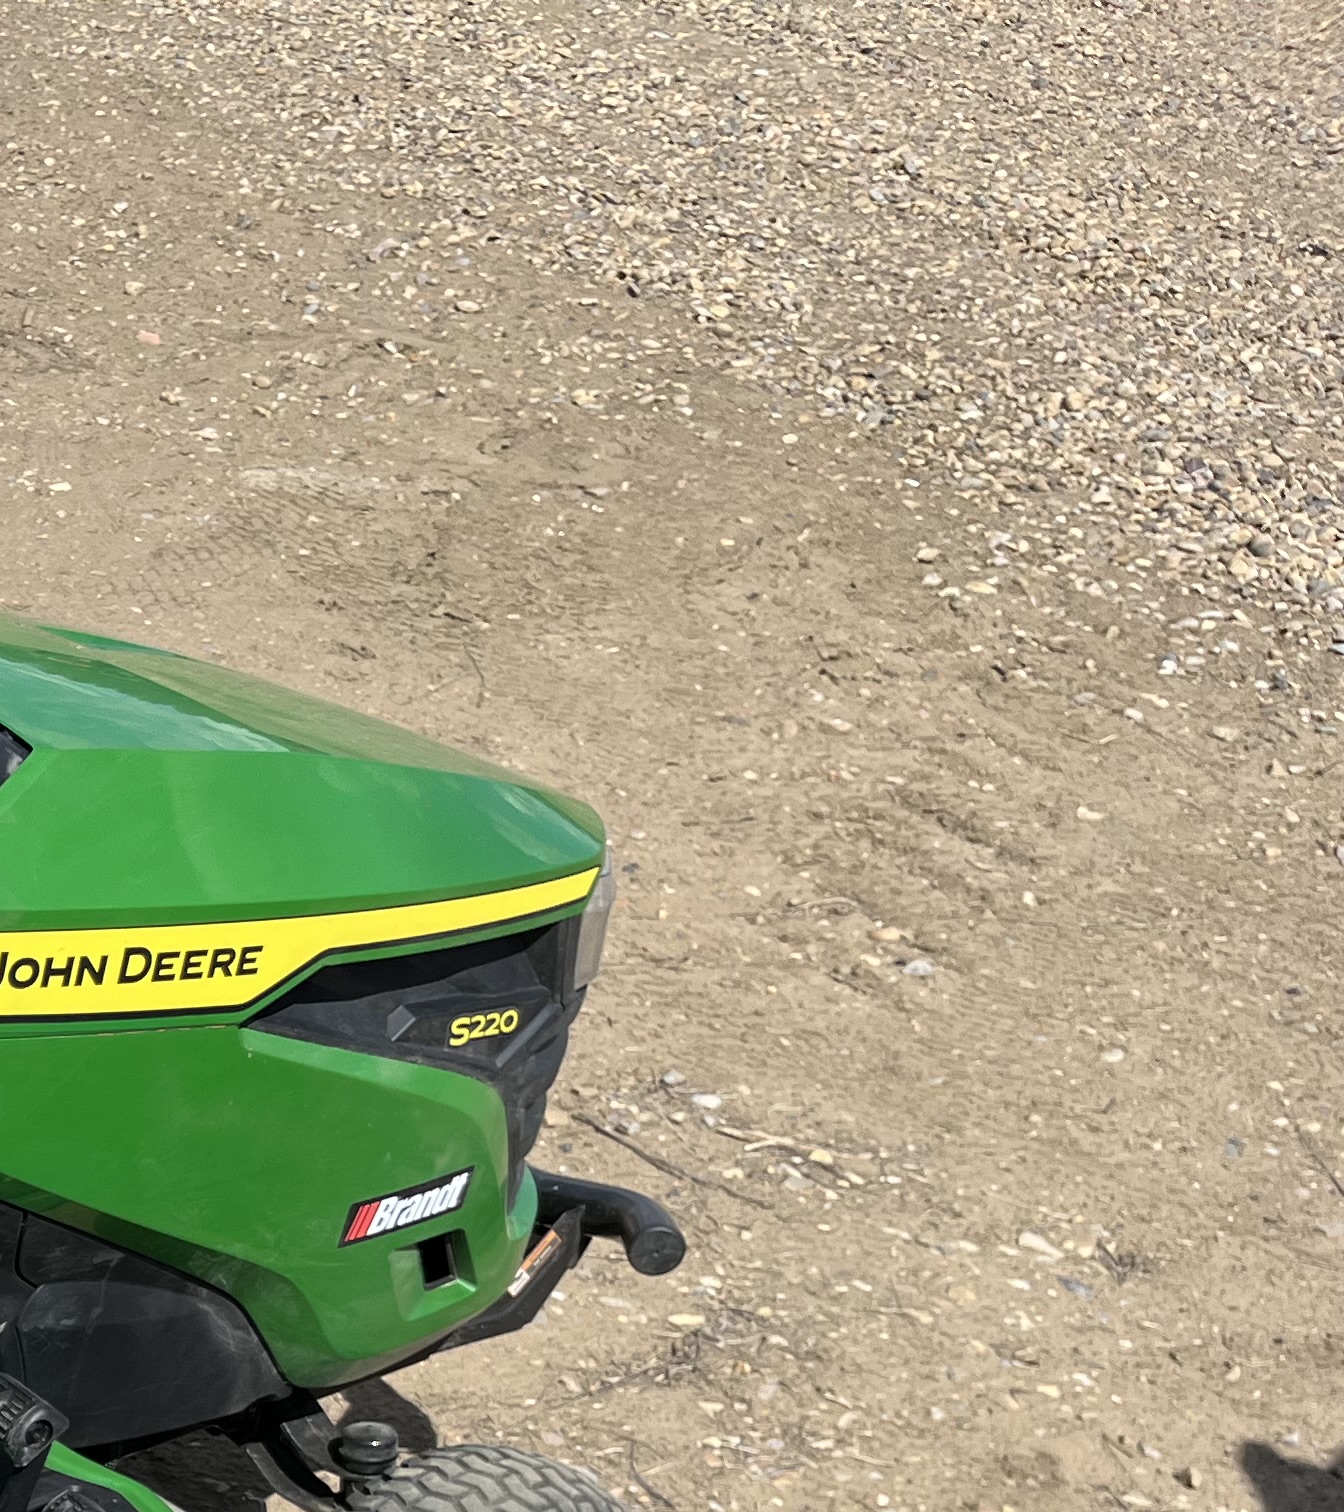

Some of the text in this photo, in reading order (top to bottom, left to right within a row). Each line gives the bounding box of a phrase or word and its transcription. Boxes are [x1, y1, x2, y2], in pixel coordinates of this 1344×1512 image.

[117, 945, 264, 985] DEERE
[448, 1009, 519, 1047] S220
[366, 1171, 469, 1237] Brandt
